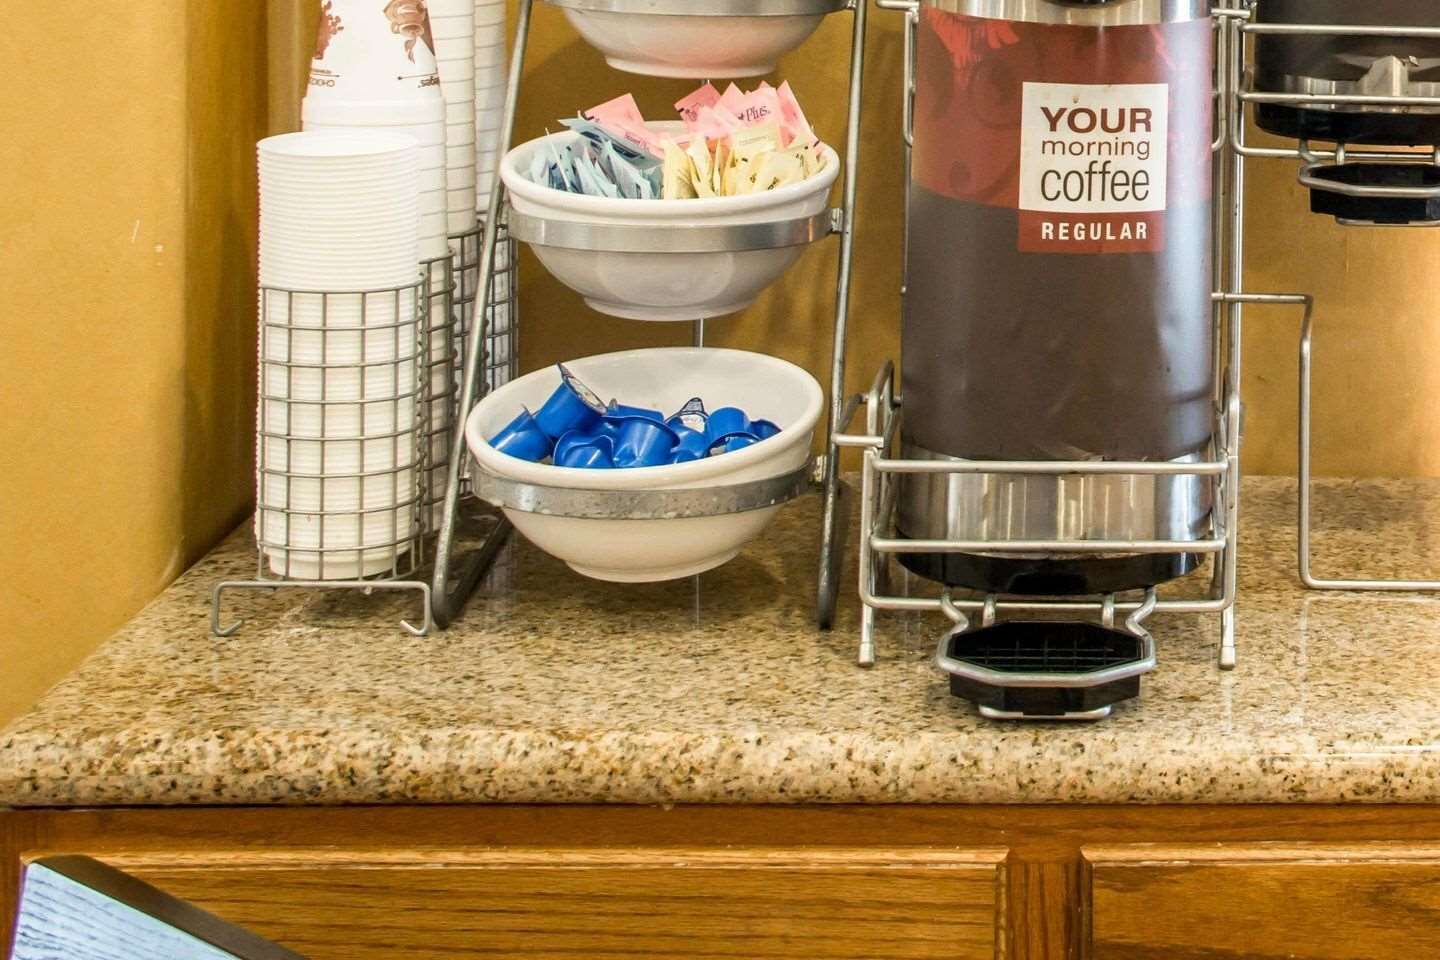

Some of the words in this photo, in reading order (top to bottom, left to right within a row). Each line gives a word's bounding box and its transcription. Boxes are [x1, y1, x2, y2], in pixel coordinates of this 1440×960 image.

[1040, 106, 1152, 134] YOUR
[1041, 137, 1150, 161] morning
[1040, 160, 1149, 202] coffee
[1041, 222, 1148, 241] REGULAR
